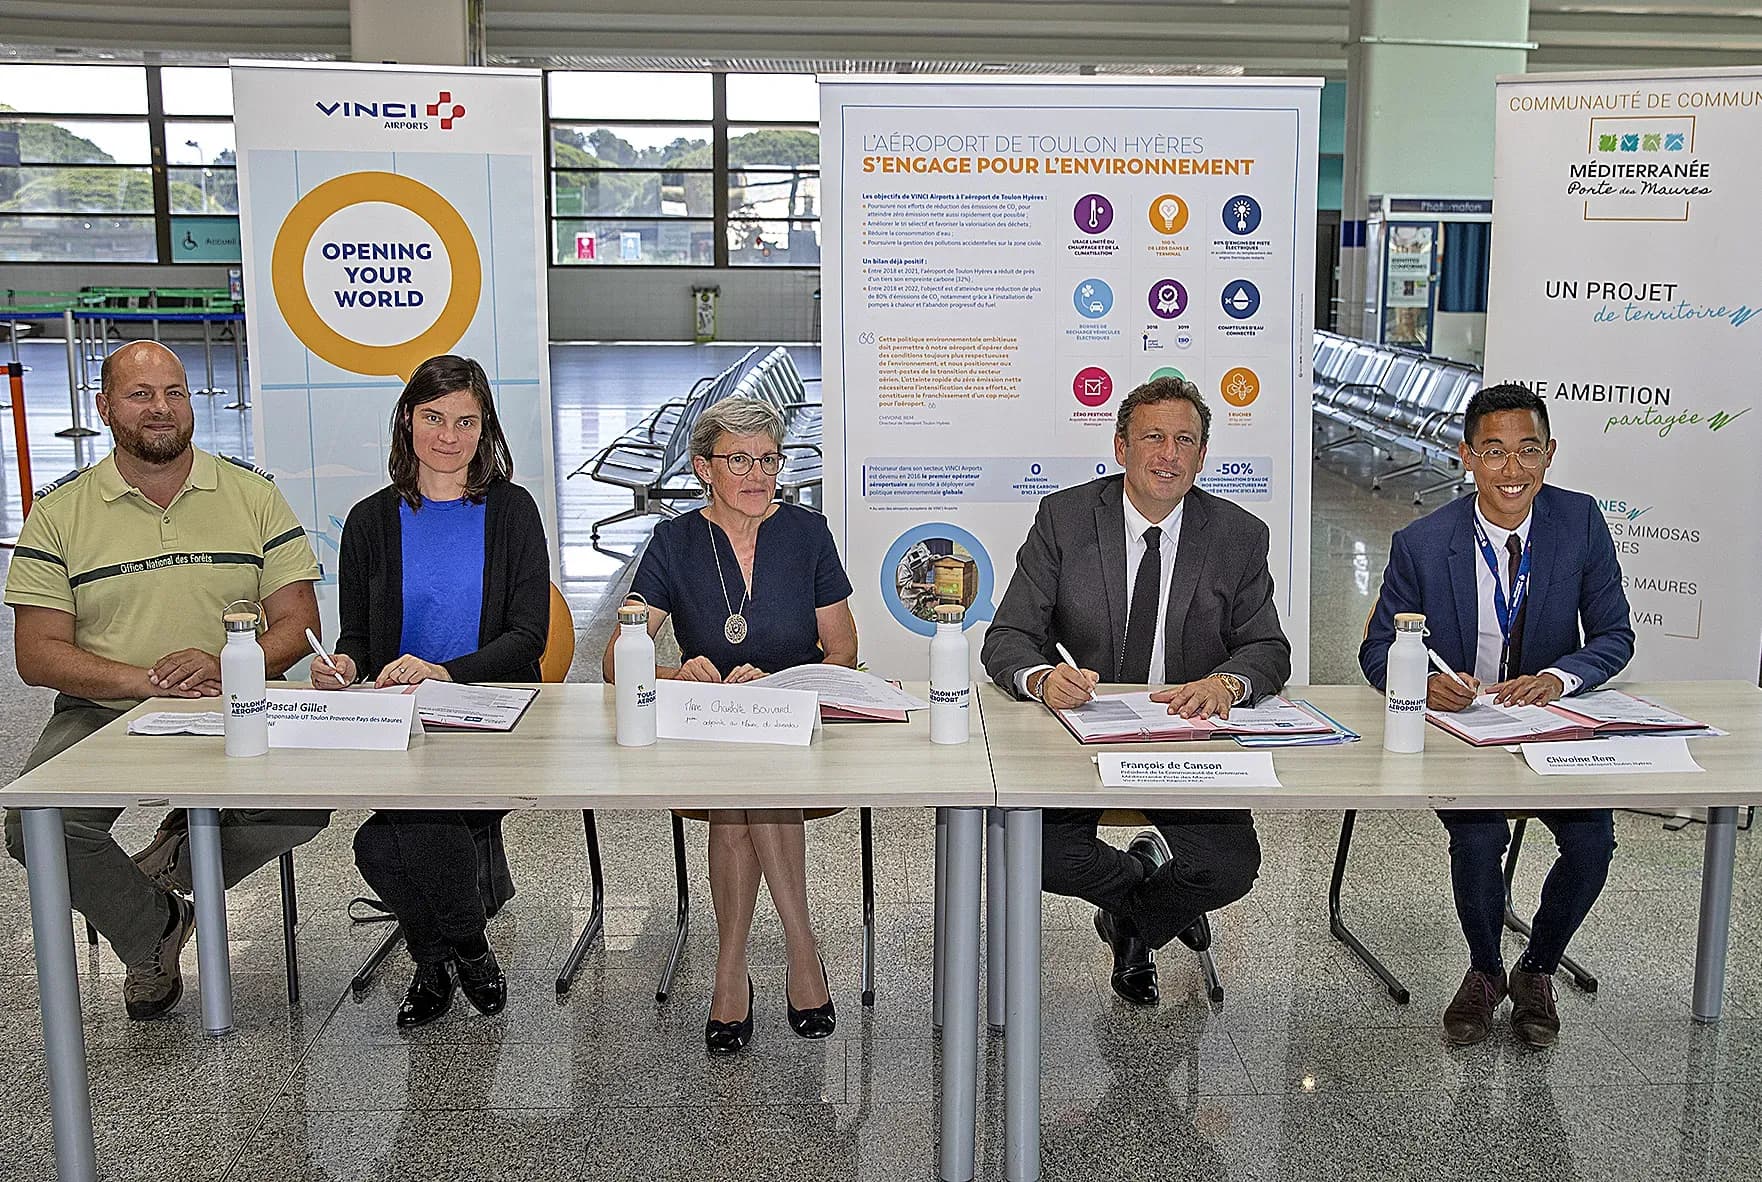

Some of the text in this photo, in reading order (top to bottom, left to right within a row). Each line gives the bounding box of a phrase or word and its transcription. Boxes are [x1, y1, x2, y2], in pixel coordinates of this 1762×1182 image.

[316, 102, 416, 118] VINCI
[1510, 91, 1641, 112] COMMUNAUTÉ
[1648, 94, 1672, 108] DE
[384, 121, 429, 130] AIRPORTS
[863, 131, 1203, 154] L'AÉROPORT DE TOULON HYÈRES
[862, 156, 1254, 175] S'ENGAGE POUR L'ENVIRONNEMENT
[1570, 160, 1710, 178] MÉDITERRANÉE
[873, 192, 900, 201] objectifs
[1568, 181, 1712, 196] Porte des Maures
[322, 243, 432, 260] OPENING
[889, 258, 902, 266] déjà
[344, 267, 412, 284] YOUR
[334, 290, 424, 307] WORLD
[1546, 282, 1678, 301] UN PROJET
[1594, 300, 1728, 322] de territoire
[1555, 382, 1670, 405] AMBITION
[1604, 407, 1704, 438] partagée
[960, 465, 982, 473] Airports
[1216, 463, 1254, 474] -50%
[1628, 525, 1700, 542] MIMOSAS
[121, 562, 144, 573] Office
[146, 556, 173, 570] National
[176, 554, 188, 564] des
[1634, 578, 1697, 595] MAURES
[1634, 612, 1662, 626] VAR
[265, 701, 327, 712] Pascal Gillet
[1389, 697, 1416, 706] TOULON
[1120, 761, 1222, 770] François de Canson
